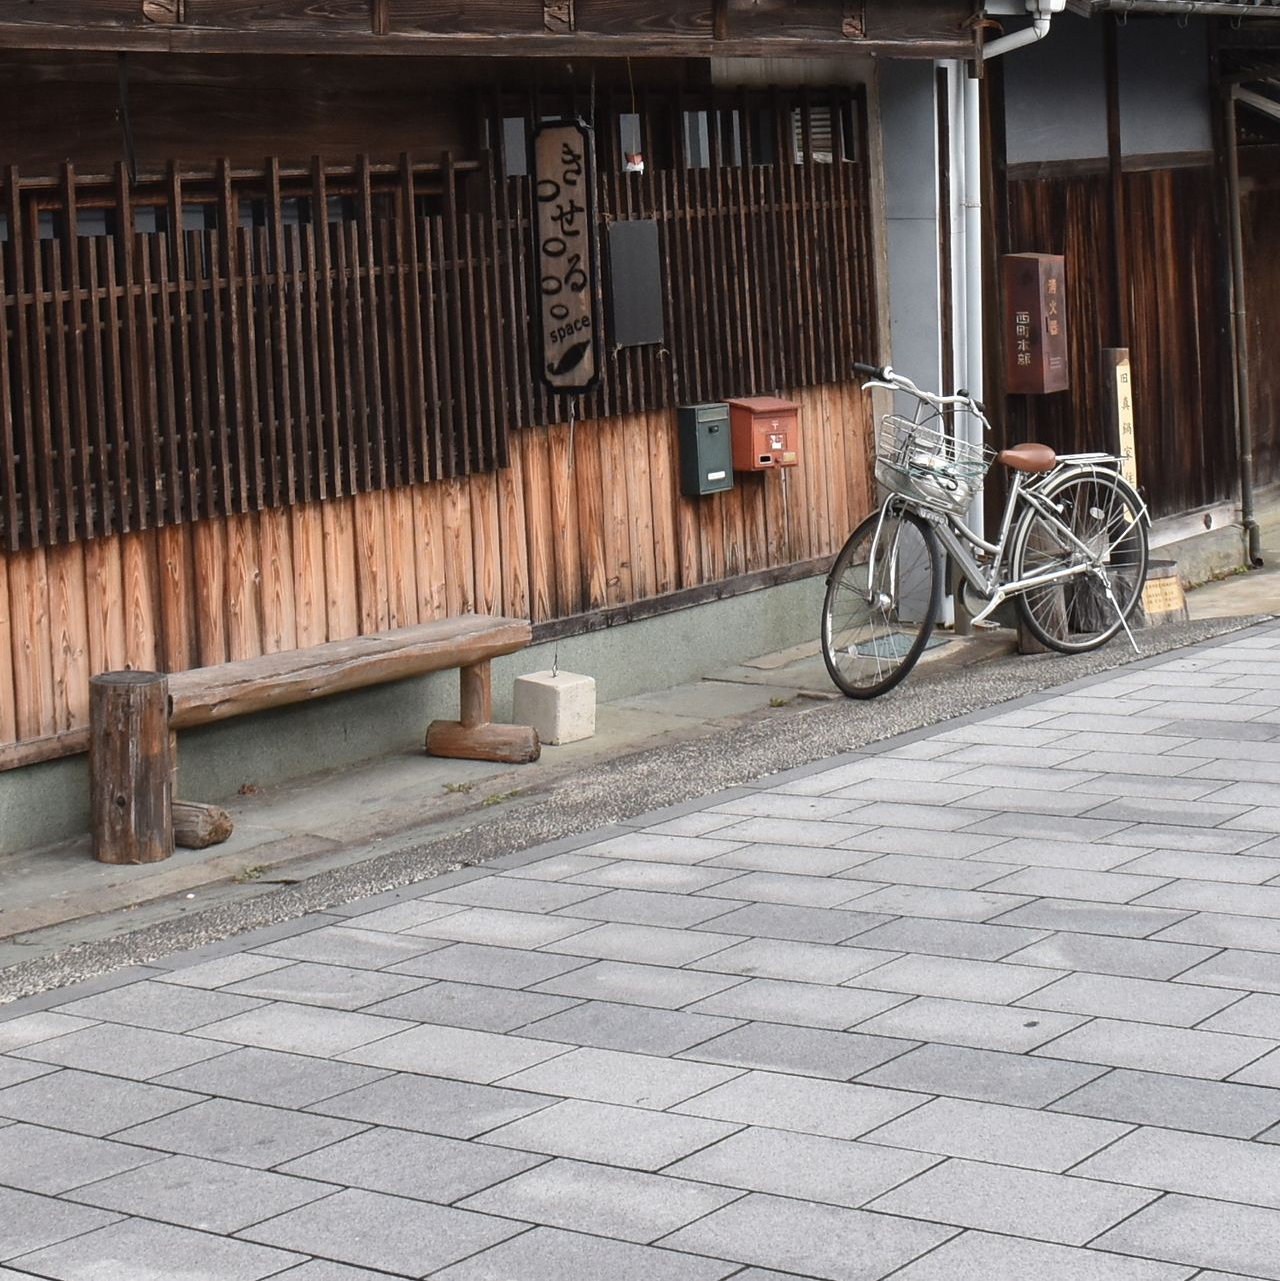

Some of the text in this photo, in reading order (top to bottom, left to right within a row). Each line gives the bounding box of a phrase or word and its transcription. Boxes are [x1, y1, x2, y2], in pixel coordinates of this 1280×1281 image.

[551, 143, 588, 292] きせる
[550, 315, 591, 345] space
[1016, 311, 1031, 366] 西町本部
[1120, 372, 1134, 485] 旧真鍋家住
